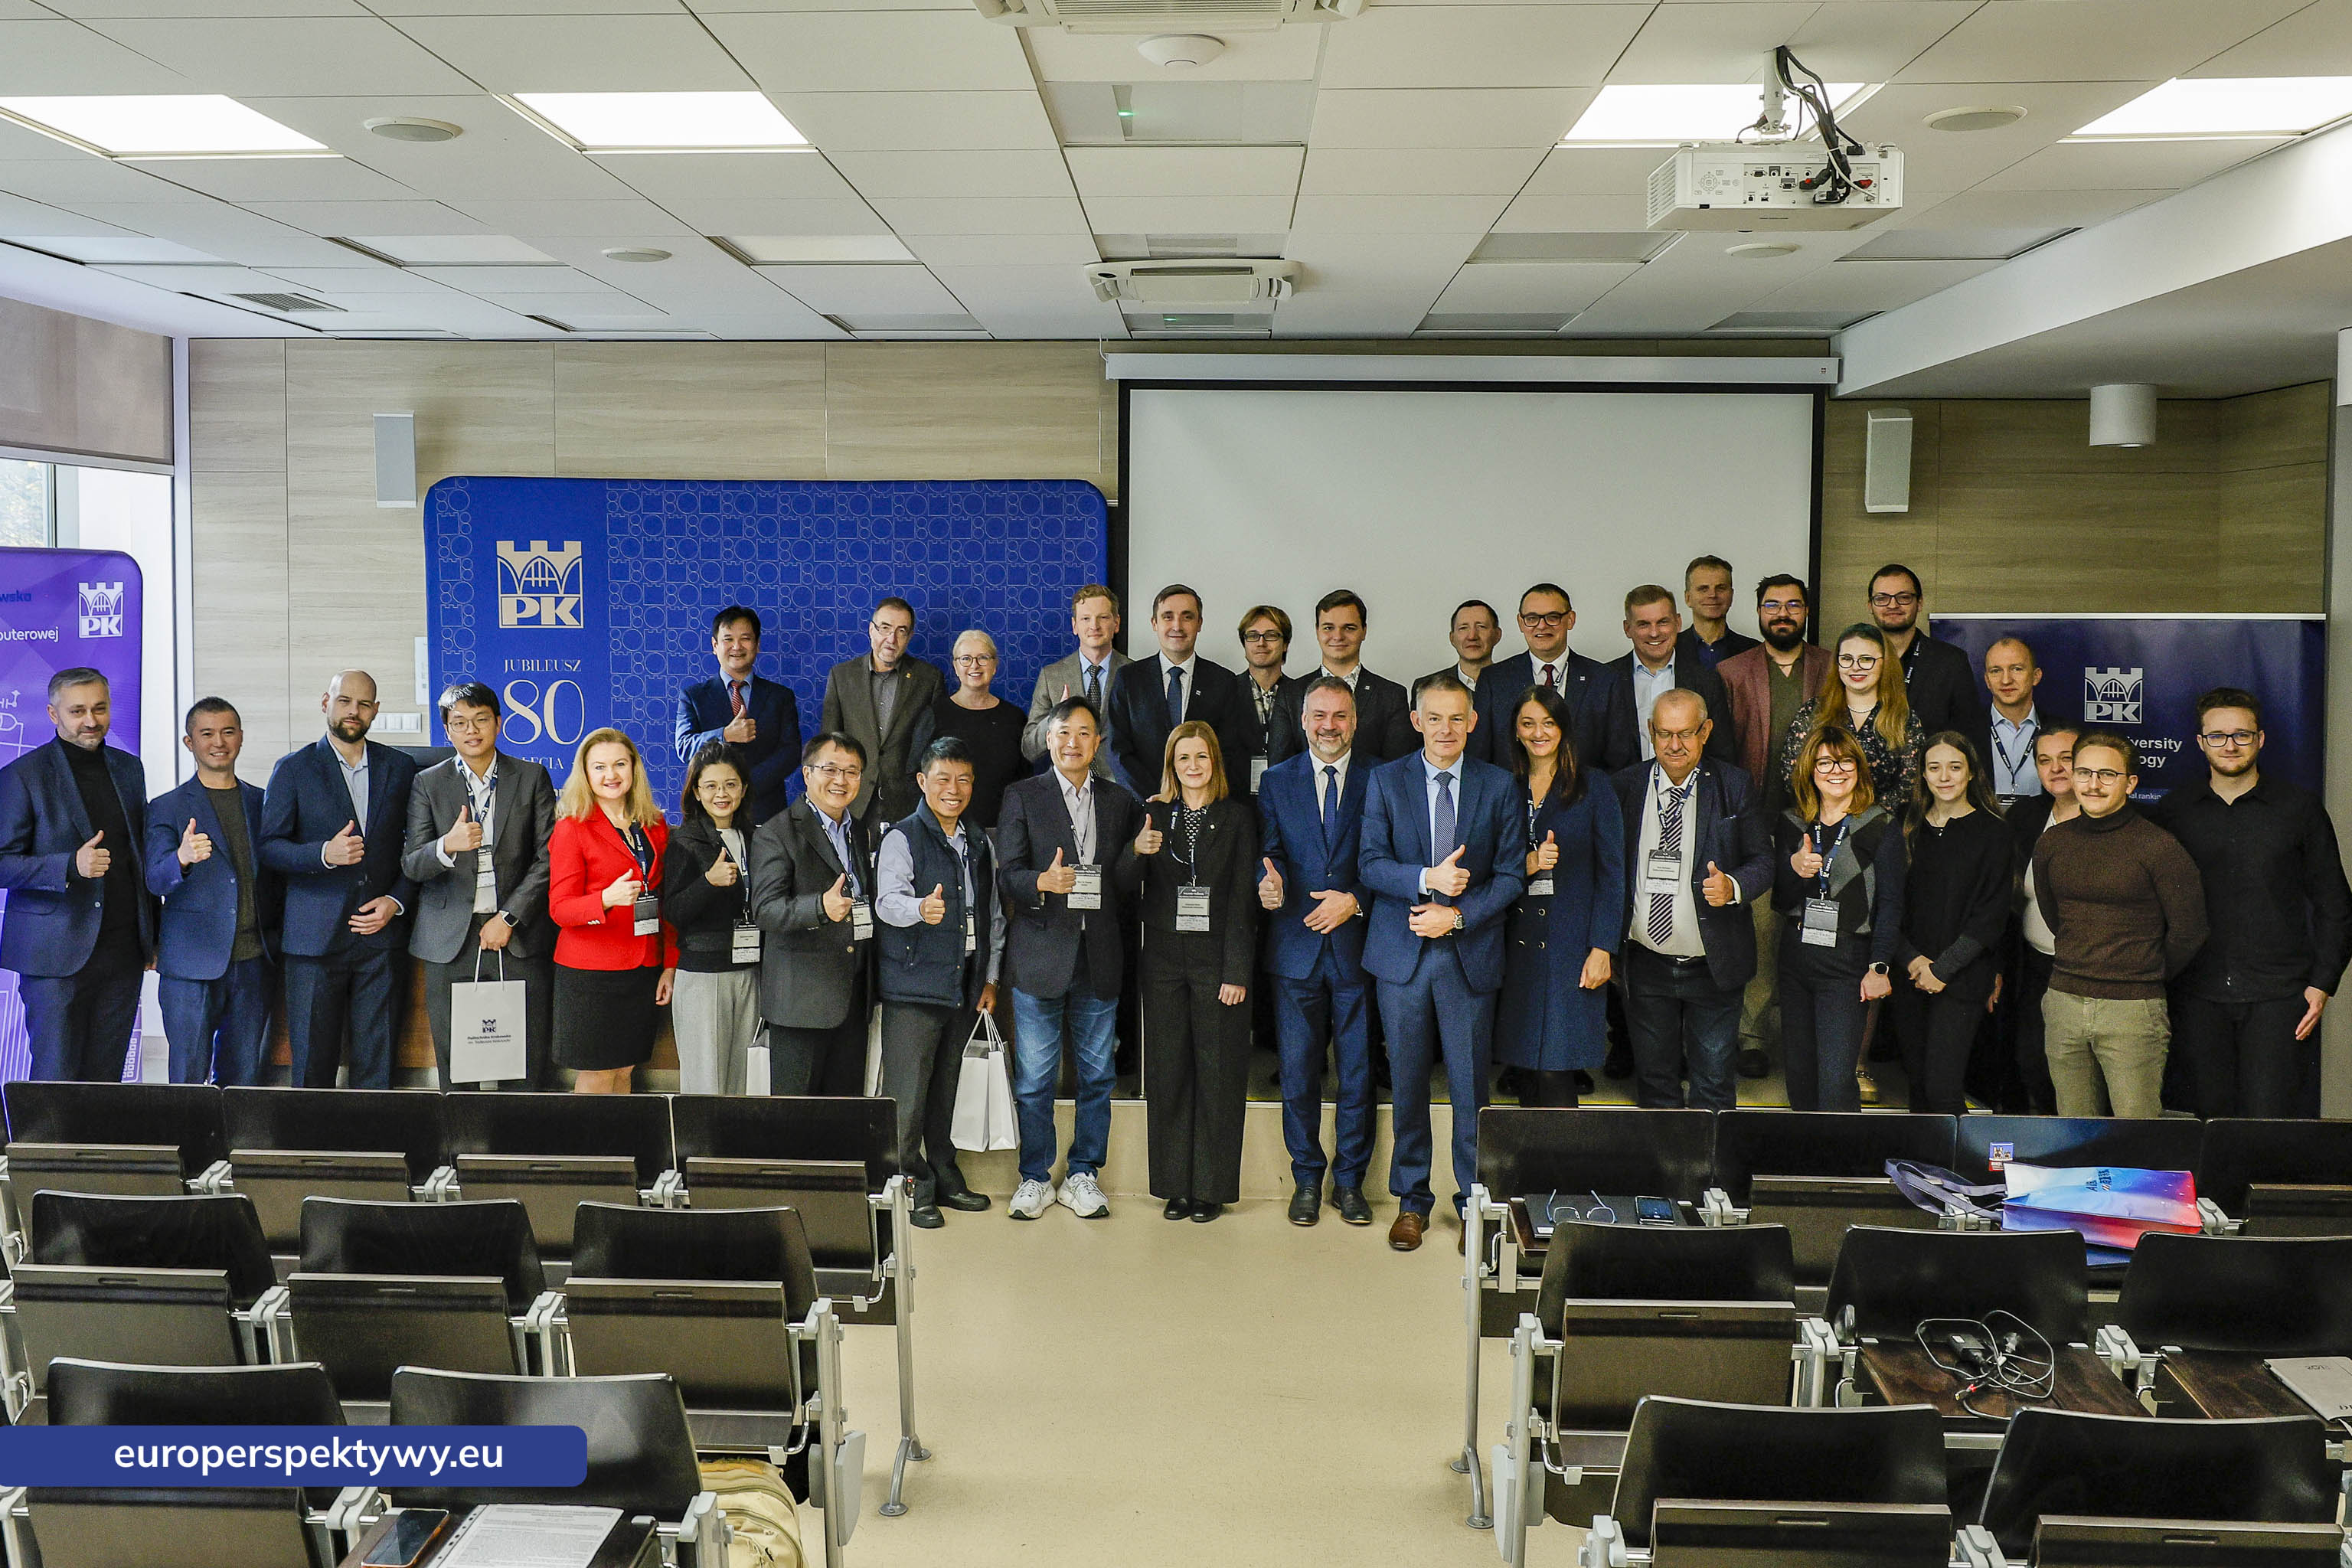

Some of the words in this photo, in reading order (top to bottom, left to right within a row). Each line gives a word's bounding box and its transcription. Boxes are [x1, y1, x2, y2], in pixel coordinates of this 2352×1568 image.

[501, 596, 581, 626] PK
[80, 616, 121, 637] PK
[504, 658, 582, 672] JUBILEUSZ
[502, 678, 586, 745] 80
[2086, 703, 2140, 721] PK
[2127, 736, 2183, 753] versity
